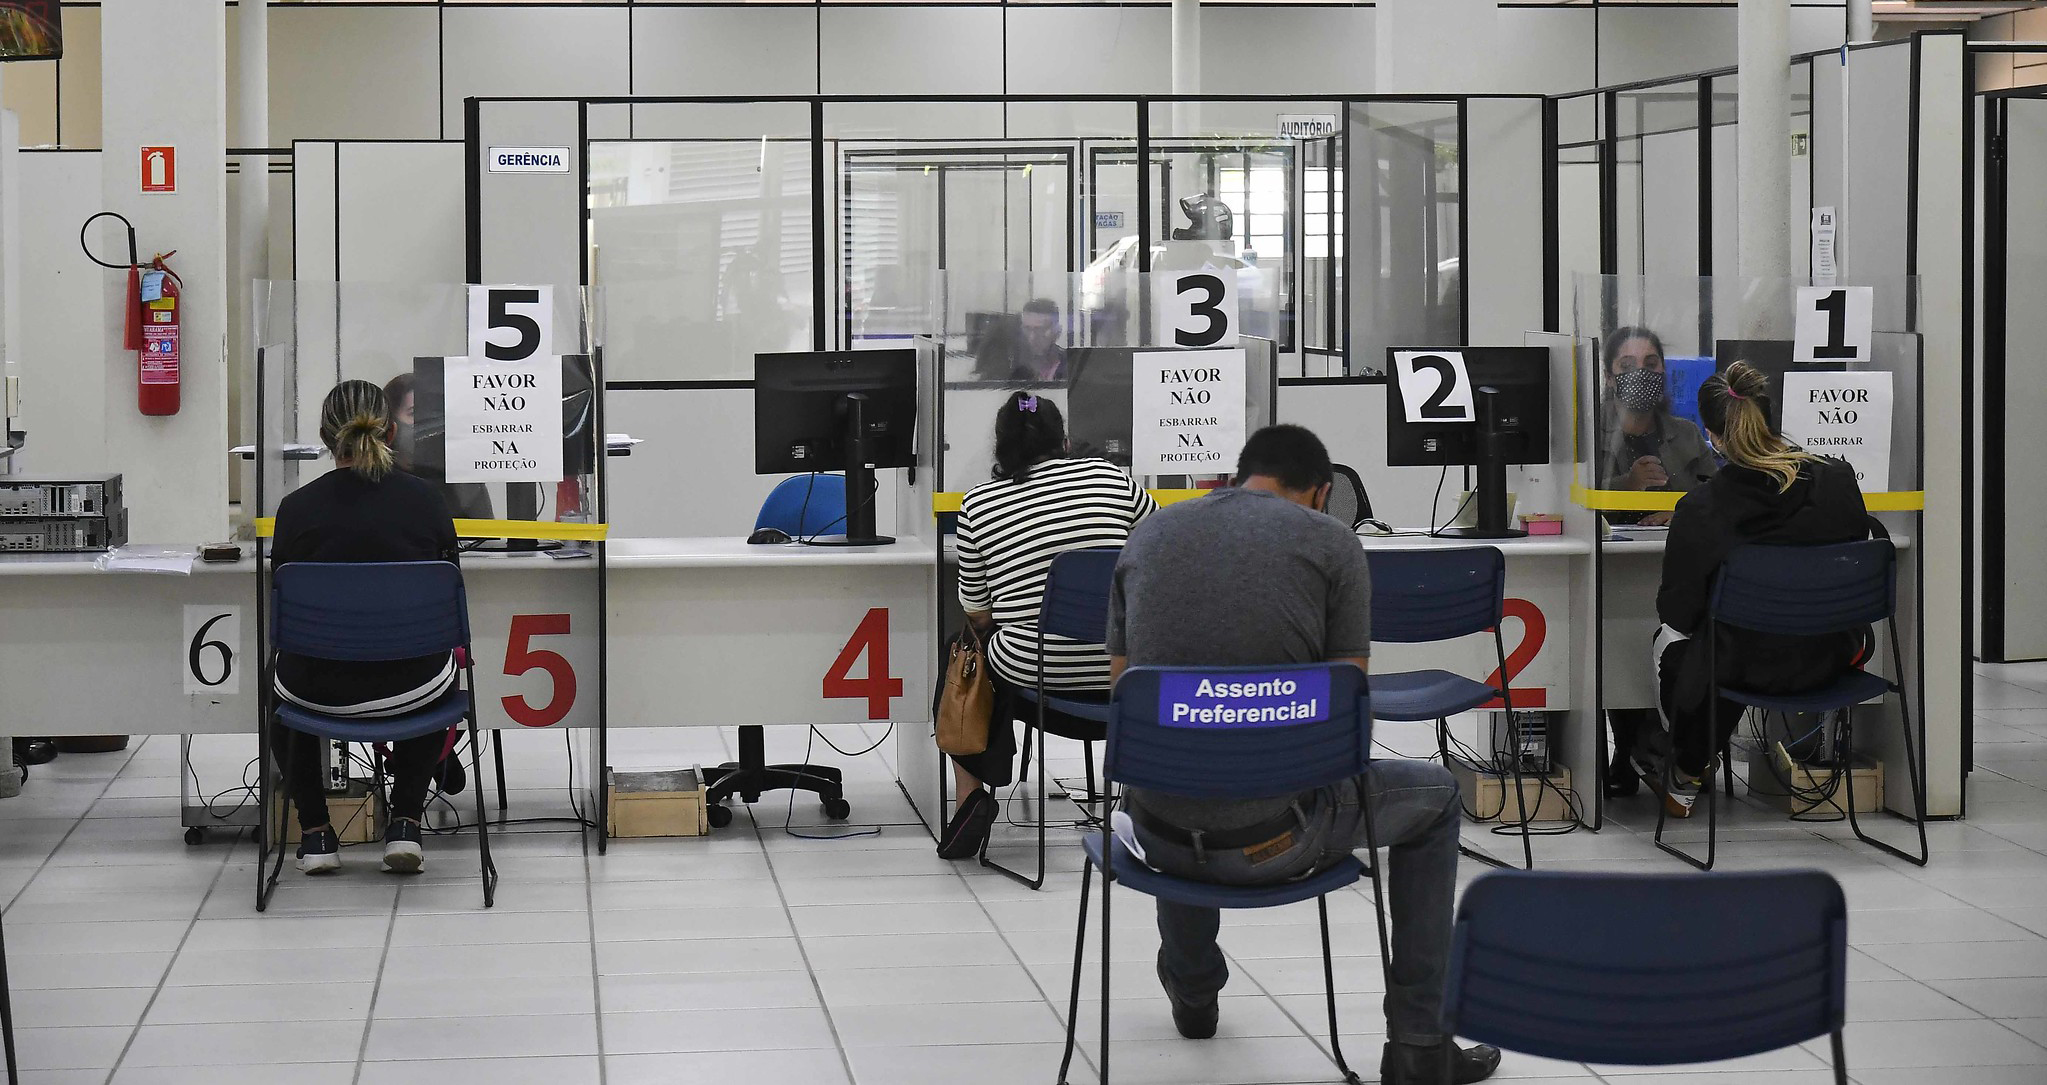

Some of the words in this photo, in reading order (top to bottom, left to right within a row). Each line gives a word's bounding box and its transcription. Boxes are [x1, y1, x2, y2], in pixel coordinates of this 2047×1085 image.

[1280, 118, 1333, 136] AUDITÓRIO
[498, 151, 561, 166] GERÊNCIA
[1174, 274, 1228, 347] 3
[484, 289, 541, 362] 5
[1812, 289, 1858, 359] 1
[472, 374, 537, 389] FAVOR
[1160, 368, 1222, 384] FAVOR
[1411, 354, 1467, 419] 2
[1809, 388, 1869, 403] FAVOR
[484, 393, 526, 411] NÃO
[1170, 387, 1211, 405] NÃO
[1159, 417, 1218, 427] ESBARRAR
[1818, 407, 1858, 425] NÃO
[472, 424, 533, 434] ESBARRAR
[491, 440, 519, 455] NA
[1178, 433, 1204, 448] NA
[1806, 437, 1863, 446] ESBARRAR
[474, 458, 537, 471] PROTEÇÃO
[1160, 451, 1221, 463] PROTEÇÃO
[189, 613, 233, 686] 6
[1475, 598, 1546, 709] 2
[501, 614, 577, 728] 5
[823, 607, 903, 720] 4
[1195, 678, 1297, 698] Assento
[1172, 699, 1318, 724] Preferencial
